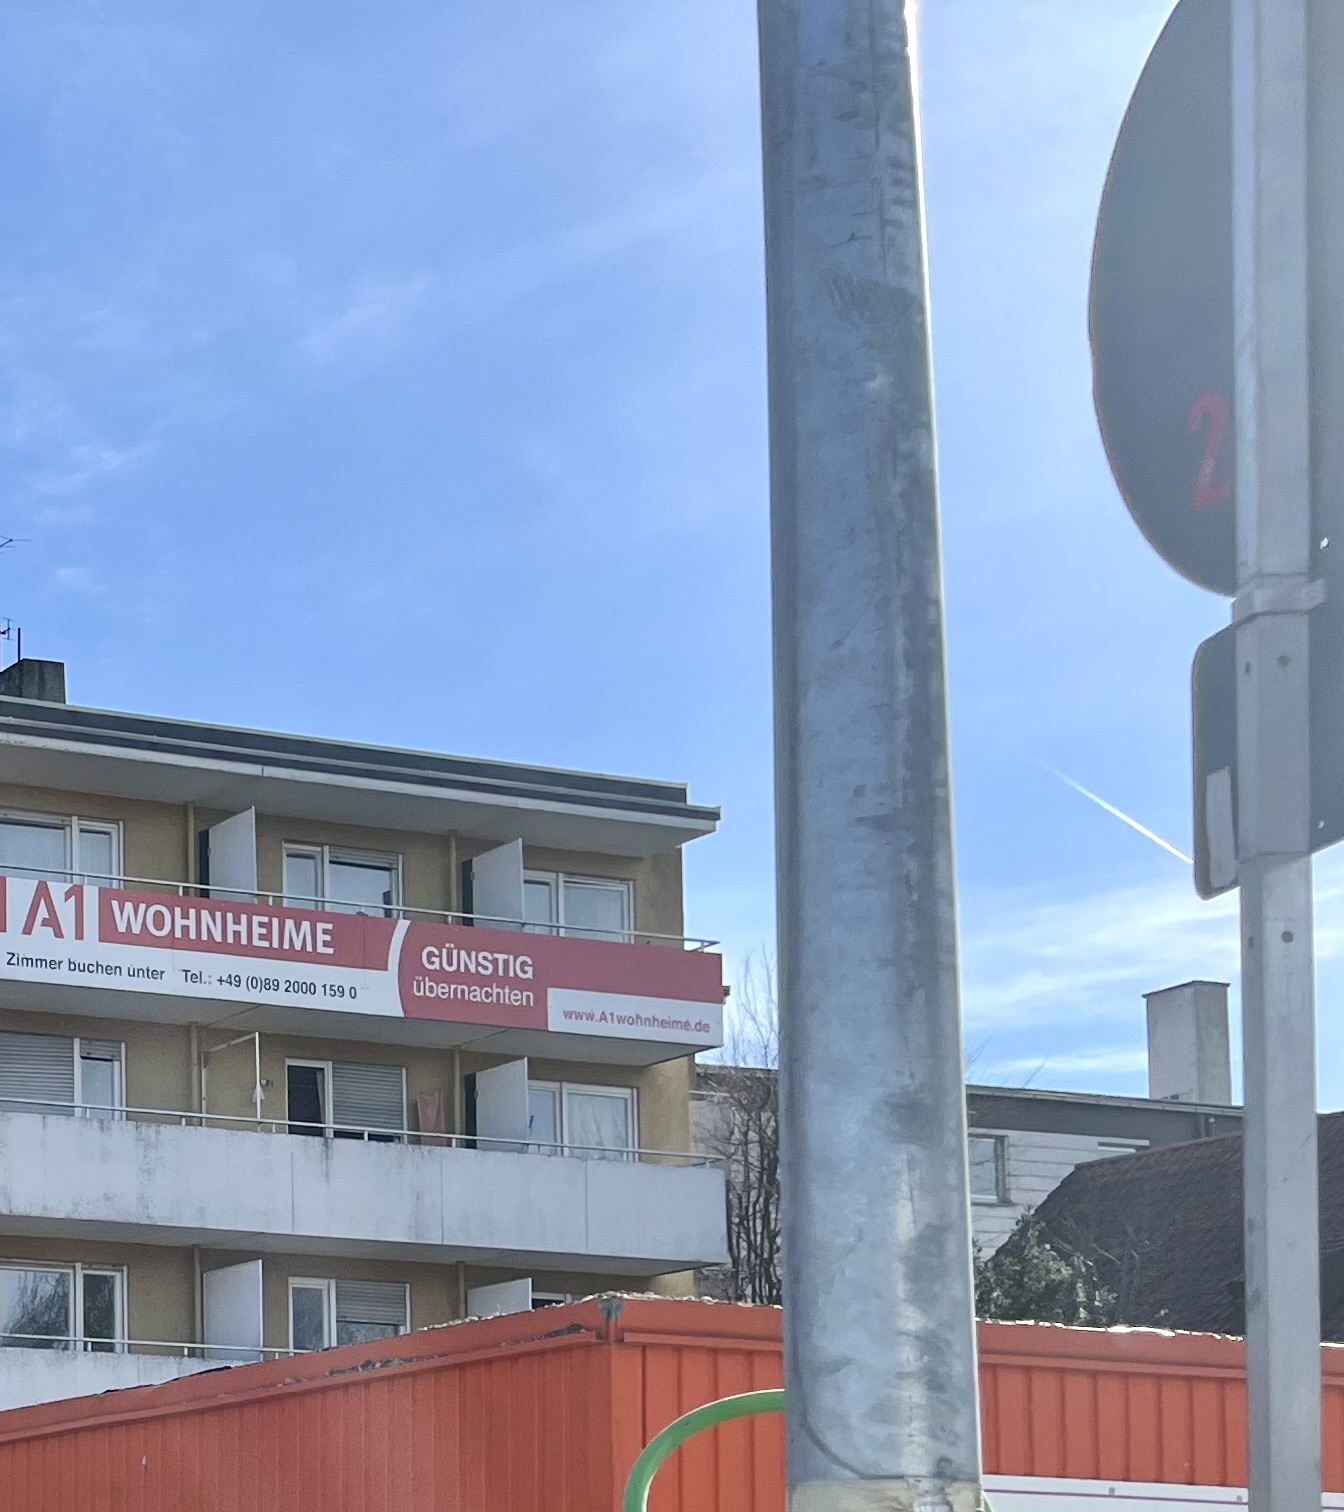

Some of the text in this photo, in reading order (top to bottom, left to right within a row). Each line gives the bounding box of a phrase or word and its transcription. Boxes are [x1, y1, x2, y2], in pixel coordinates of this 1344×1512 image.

[21, 880, 335, 955] A1 WOHNHEIME
[6, 951, 64, 971] Zimmer
[67, 958, 123, 977] buchen
[127, 965, 165, 981] unter
[216, 974, 242, 989] +49
[245, 976, 280, 994] (0)89
[284, 979, 317, 996] 2000
[321, 983, 345, 998] 159
[349, 985, 357, 999] 0
[421, 943, 534, 980] GÜNSTIG
[413, 976, 534, 1007] übernachten
[562, 1008, 711, 1033] www.A1wohnheime.de
